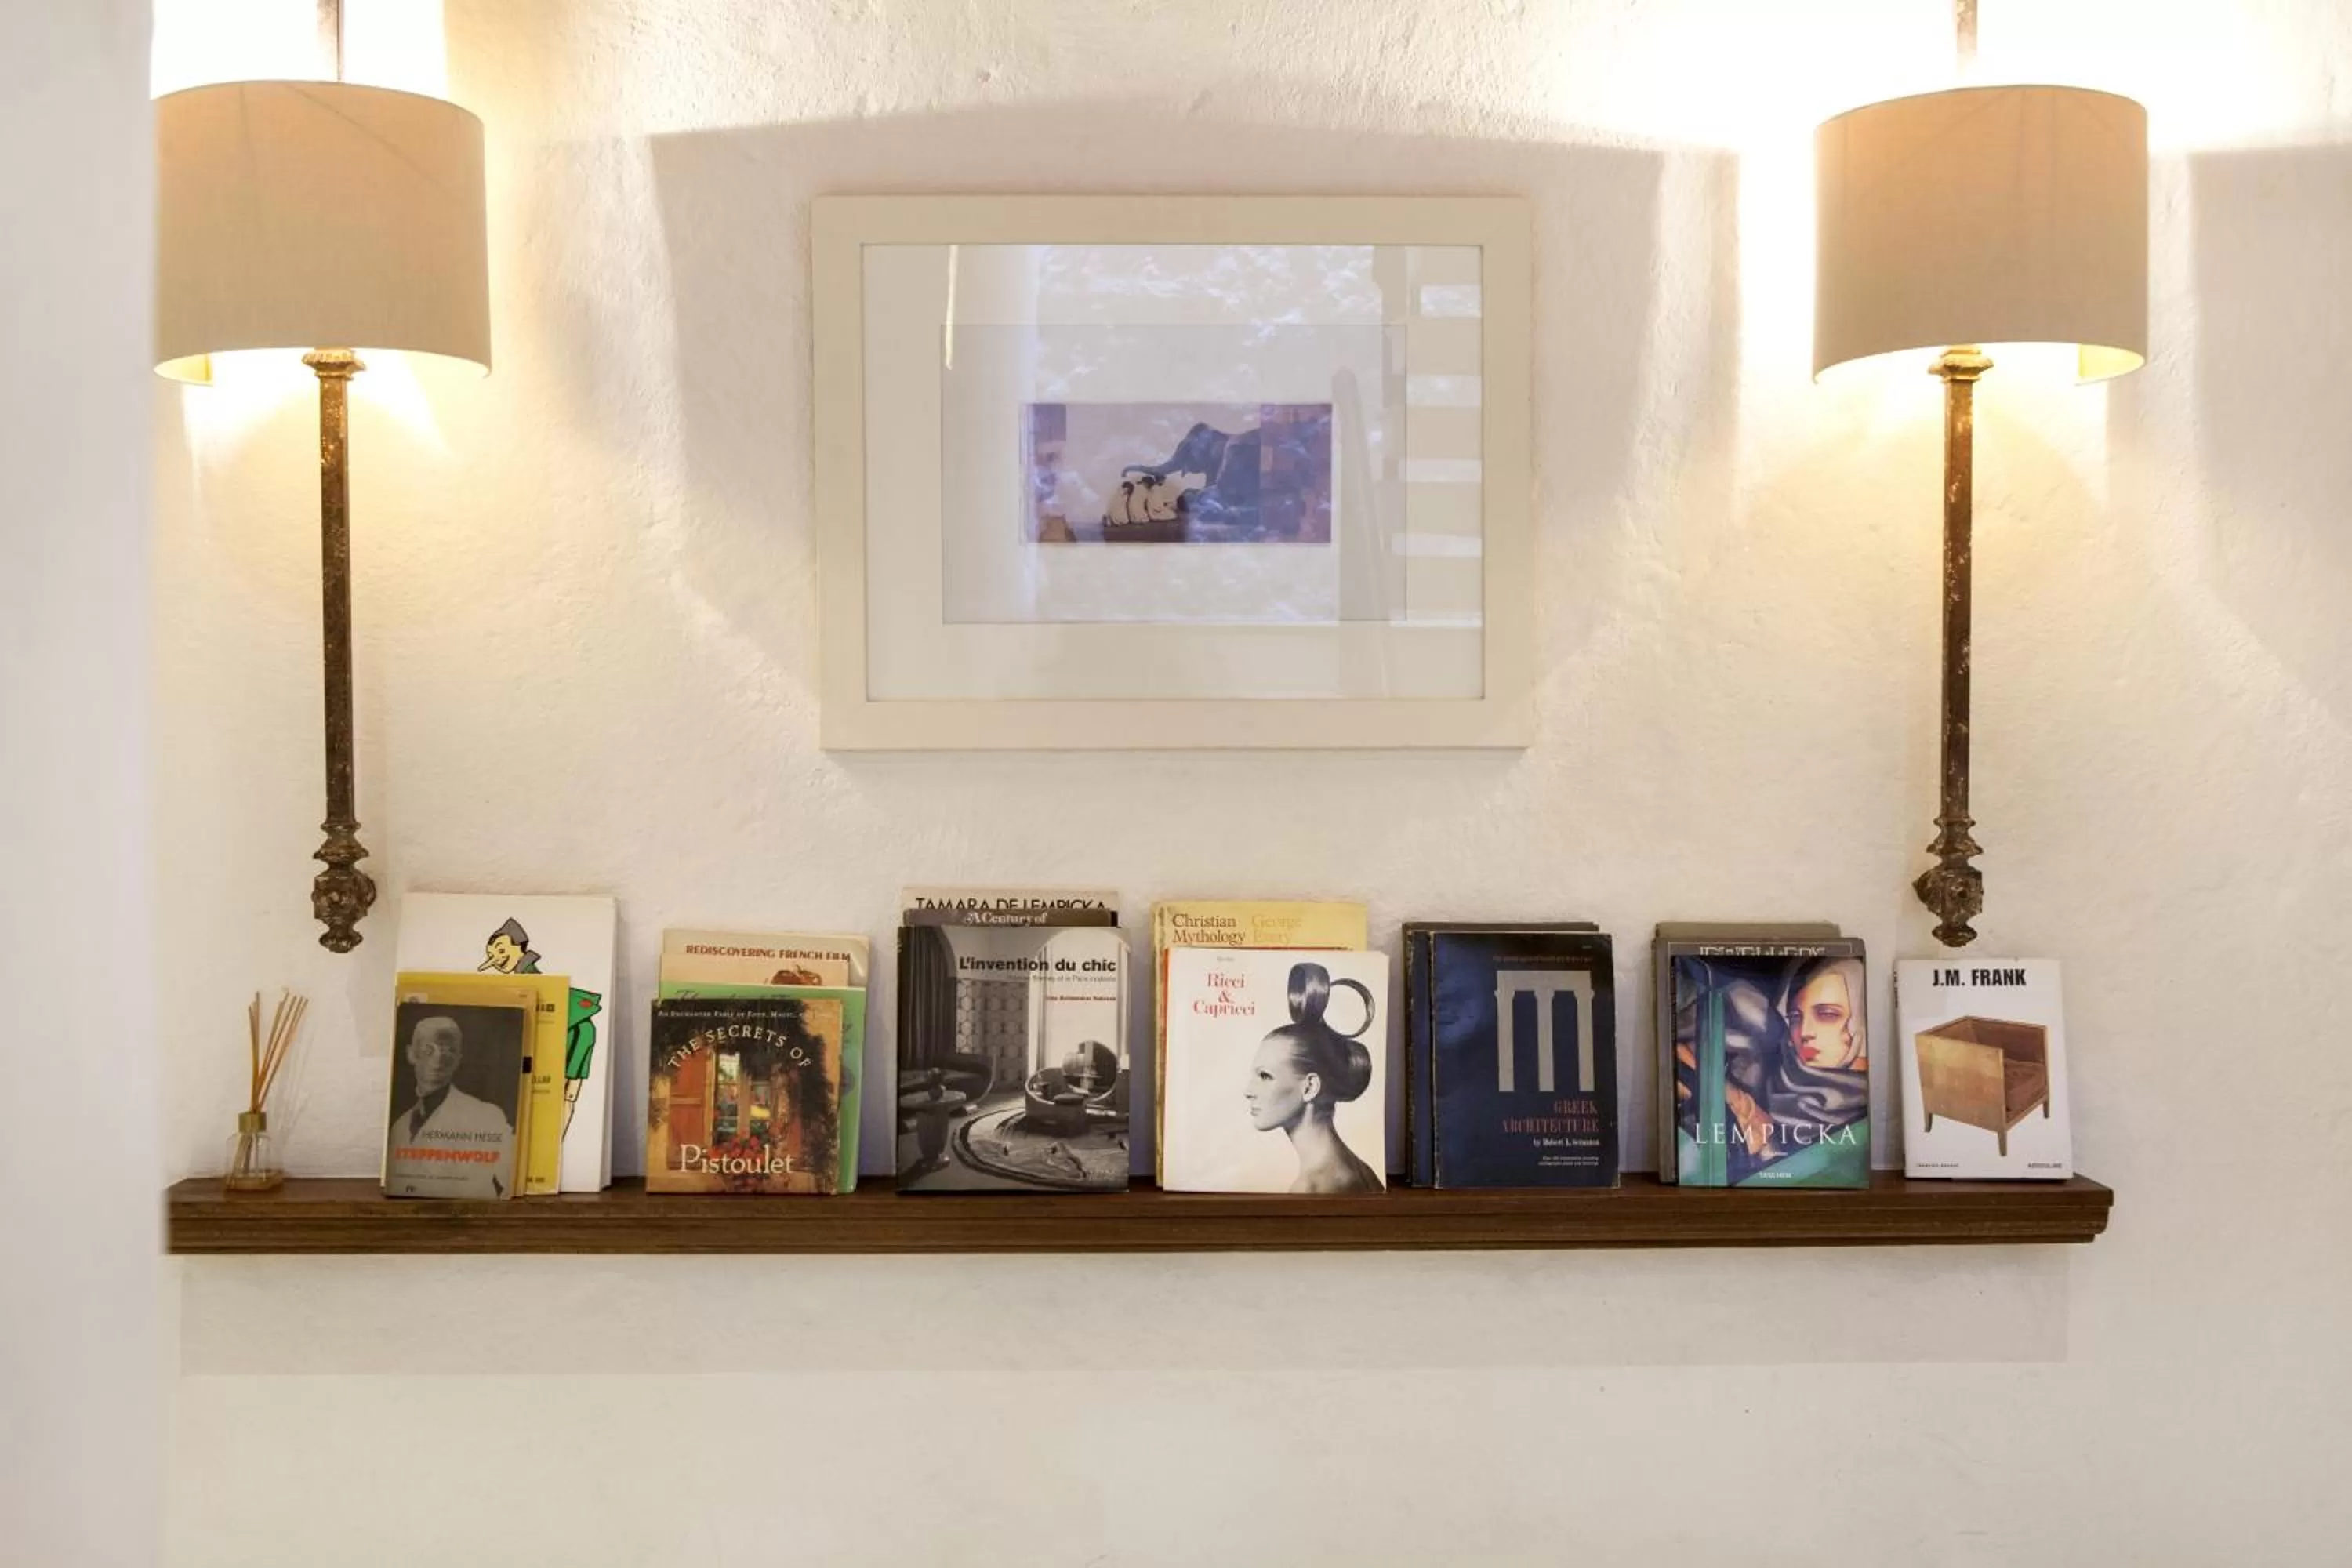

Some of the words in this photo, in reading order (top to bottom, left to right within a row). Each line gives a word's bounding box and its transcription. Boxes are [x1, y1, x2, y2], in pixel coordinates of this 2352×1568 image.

[980, 912, 1032, 927] Century
[1034, 912, 1048, 924] of
[1172, 913, 1236, 928] Christian
[1173, 929, 1246, 946] Mythology
[686, 944, 775, 958] REDISCOVERING
[779, 949, 823, 960] FRENCH
[826, 951, 851, 962] FILM
[959, 956, 1048, 971] L'invention
[1054, 958, 1076, 971] du
[1081, 957, 1117, 971] chic
[1207, 972, 1245, 989] Ricci
[1932, 968, 1965, 987] J.M.
[1971, 968, 2027, 987] FRANK
[1218, 990, 1231, 1004] &
[1192, 1000, 1256, 1019] Capricci
[667, 1039, 702, 1069] THE
[705, 1025, 787, 1047] SECRETS
[789, 1047, 812, 1068] OF
[1554, 1099, 1598, 1114] GREEK
[421, 1130, 472, 1142] HERMANN
[1695, 1122, 1857, 1145] LEMPICKA
[395, 1147, 502, 1163] STEPPENWOLF
[680, 1143, 795, 1174] Pistoulet
